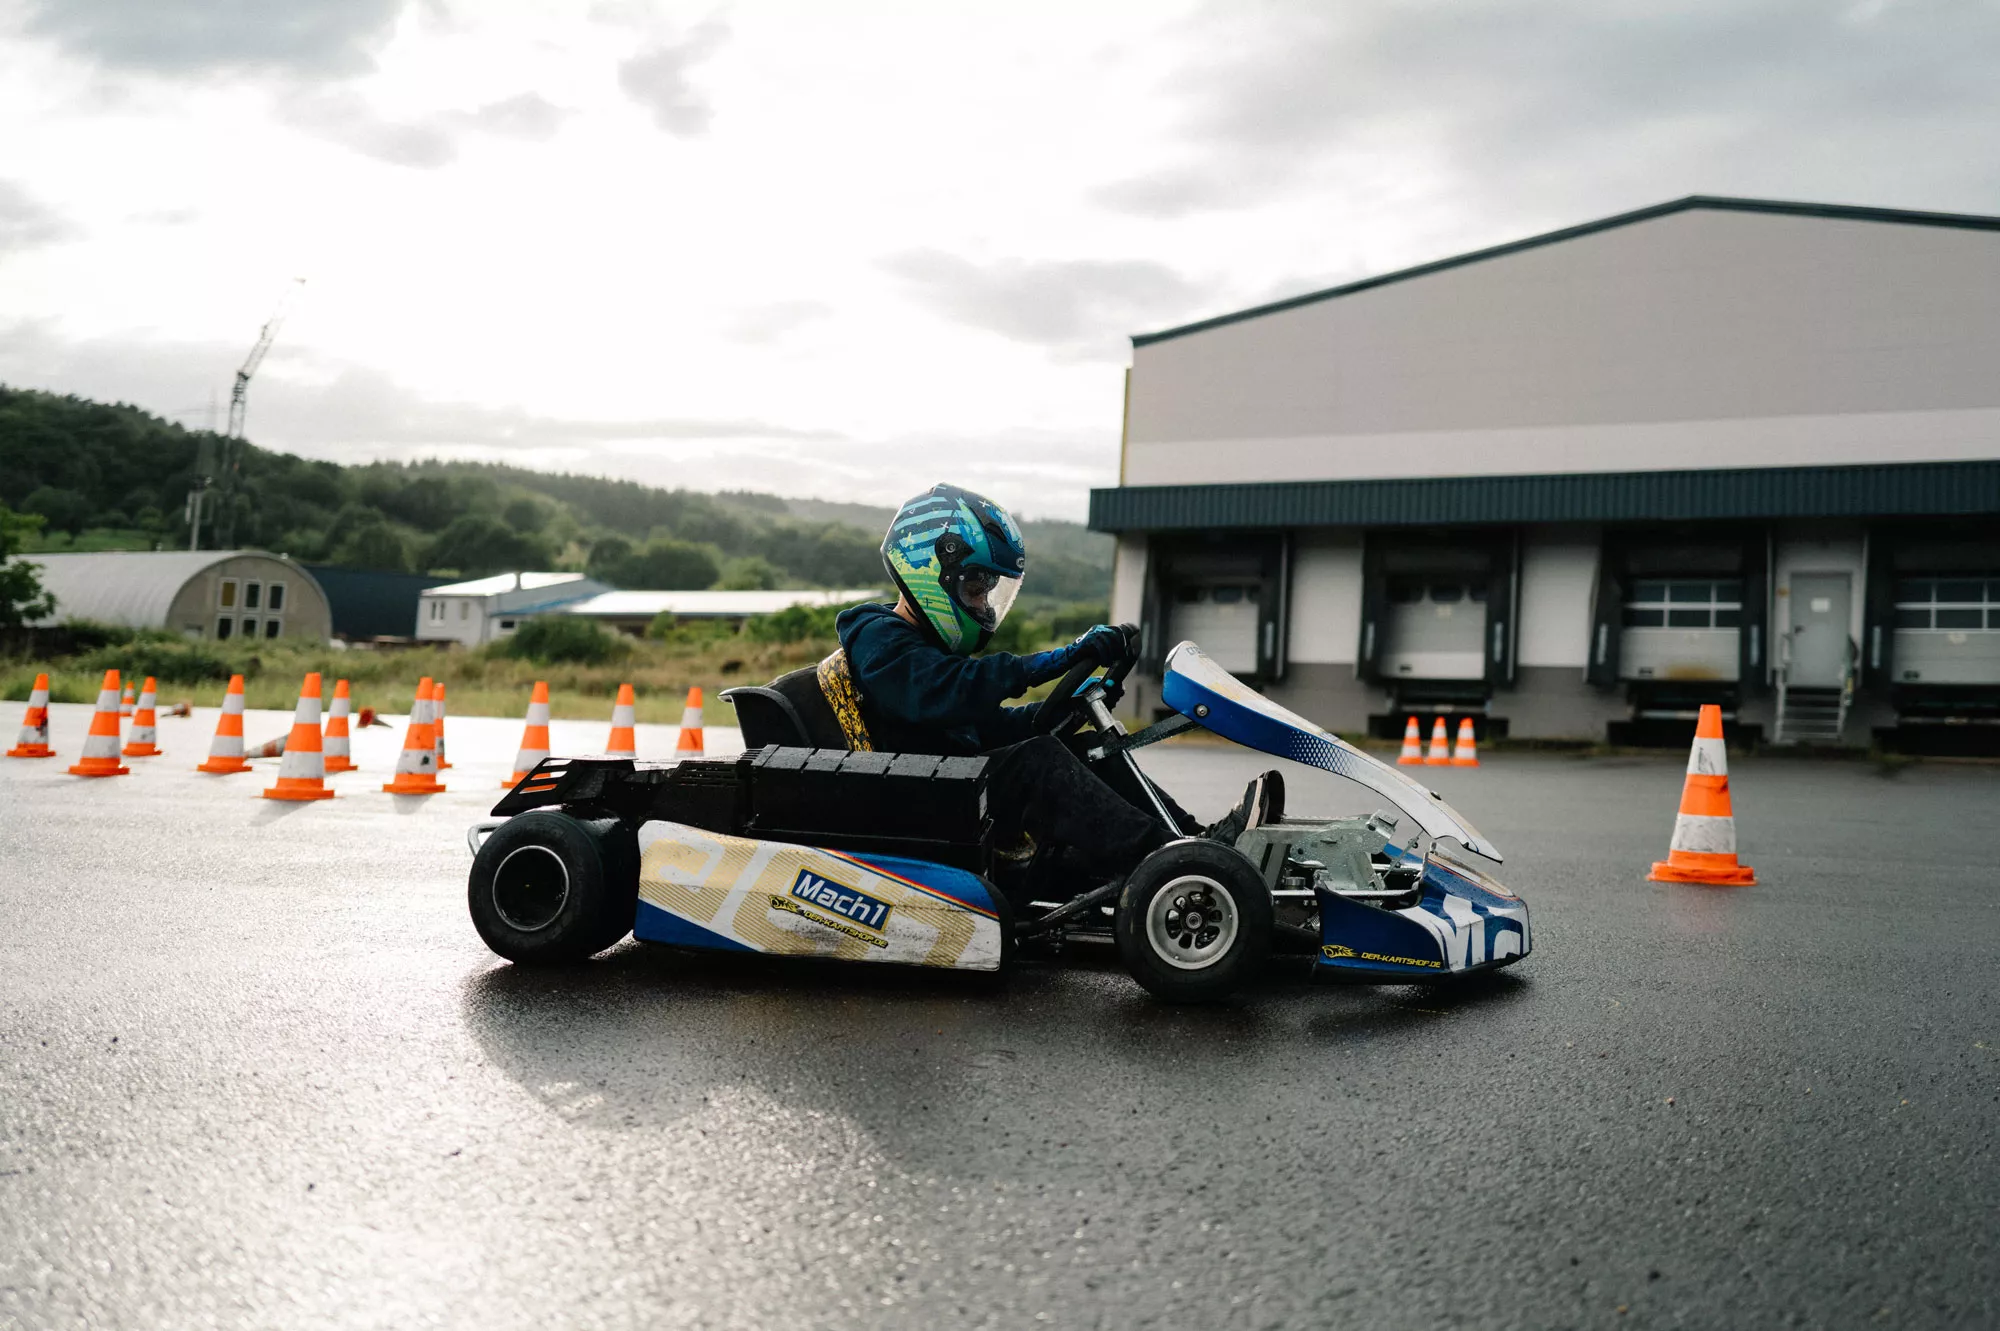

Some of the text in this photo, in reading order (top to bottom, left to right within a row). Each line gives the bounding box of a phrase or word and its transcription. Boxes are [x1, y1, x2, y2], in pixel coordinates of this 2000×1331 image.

[795, 874, 886, 925] Mach1
[804, 911, 888, 947] DER-KARTSHOP.DE
[1361, 952, 1441, 968] DER-KARTSHOP.DE
